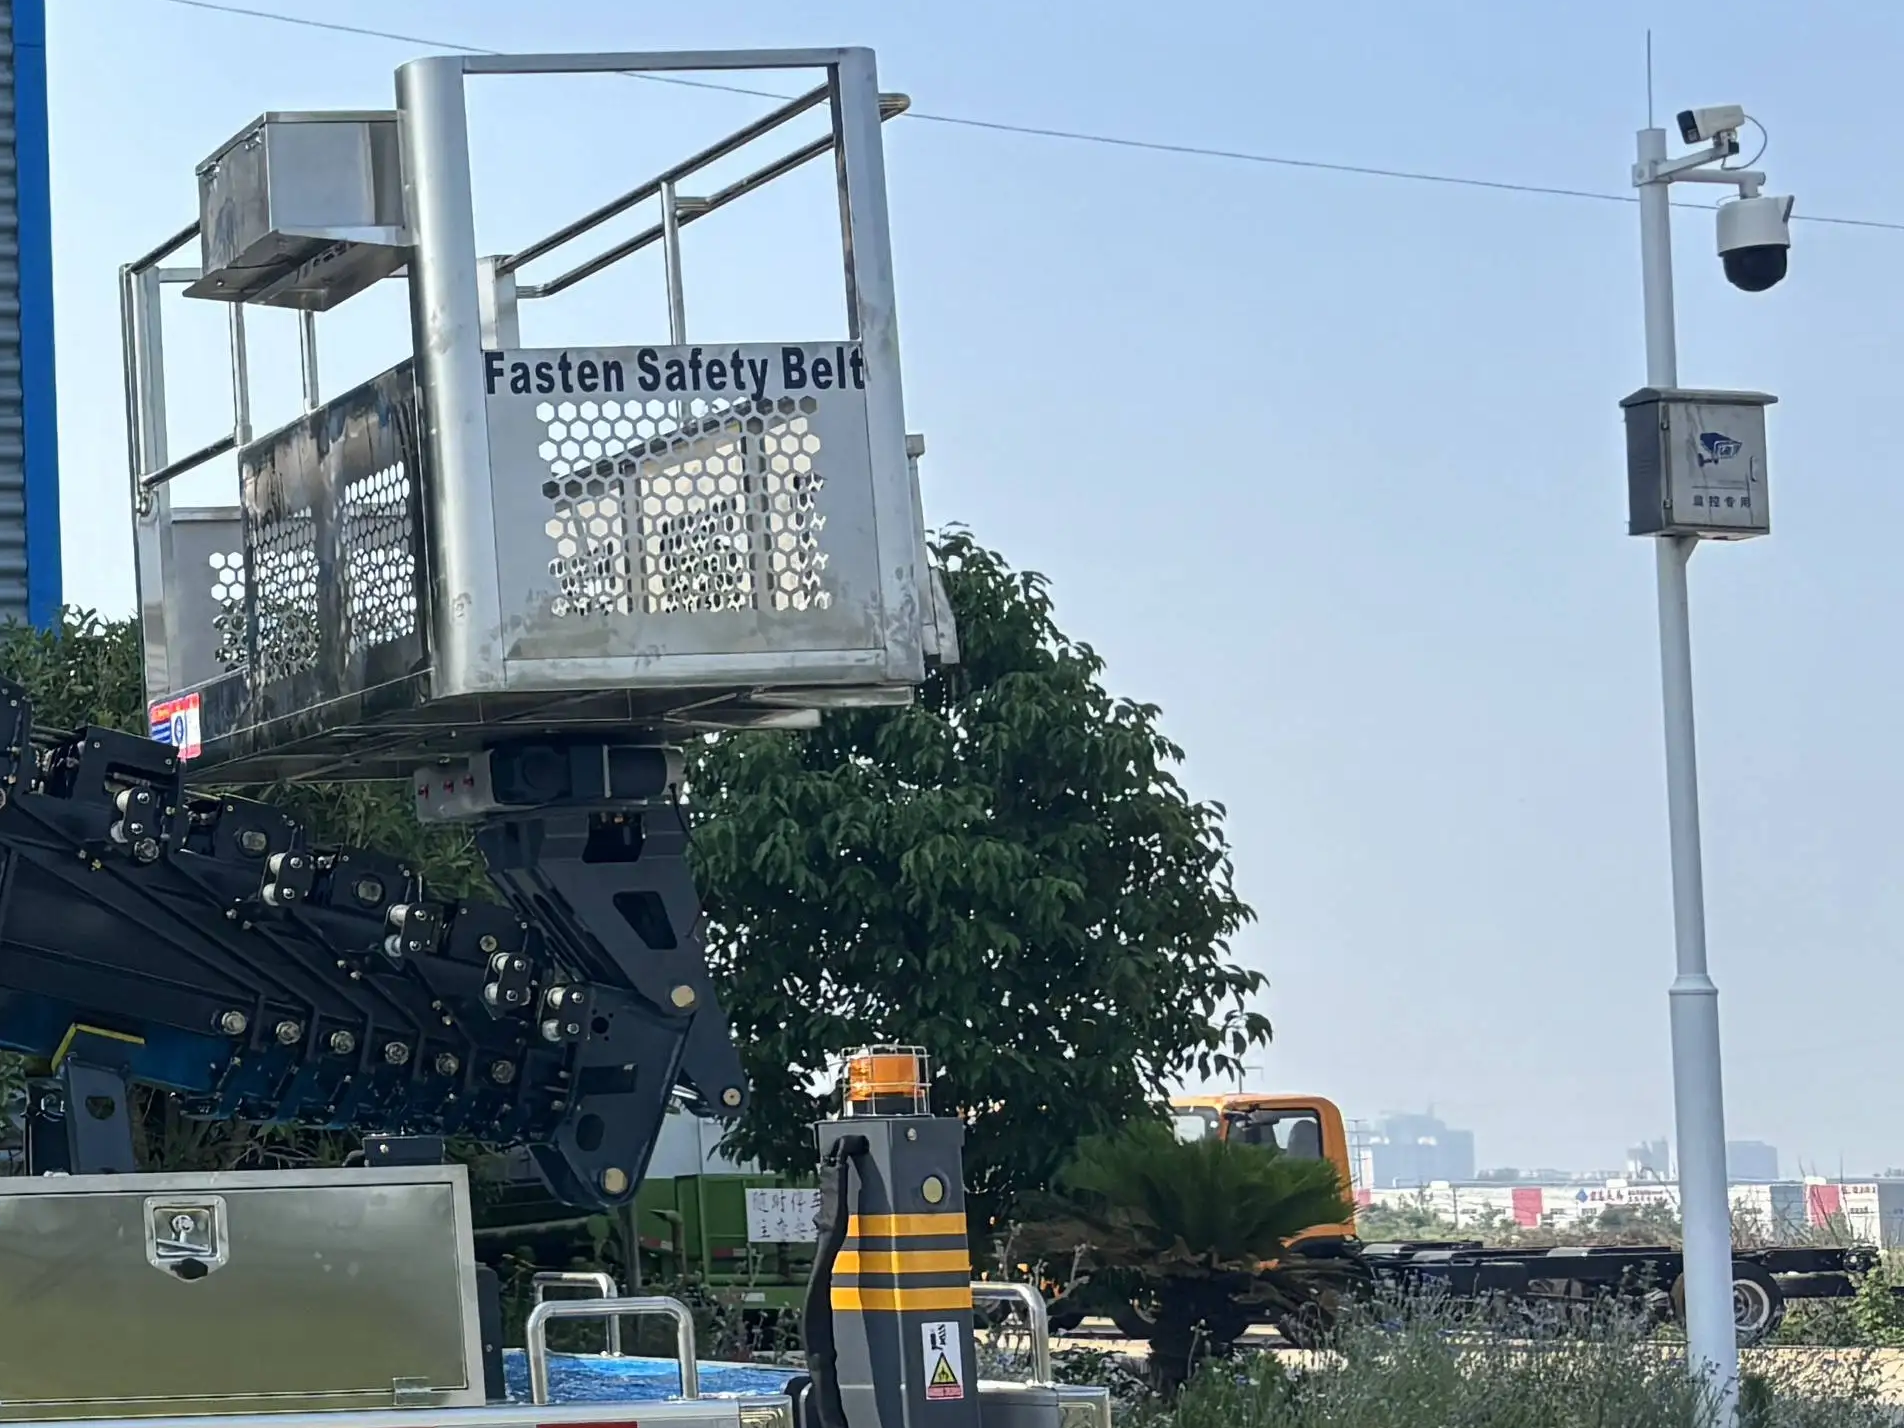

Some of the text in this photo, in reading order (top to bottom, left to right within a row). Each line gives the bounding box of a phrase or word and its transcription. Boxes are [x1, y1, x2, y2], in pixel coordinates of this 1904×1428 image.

[485, 346, 865, 401] Fasten Safety Belt
